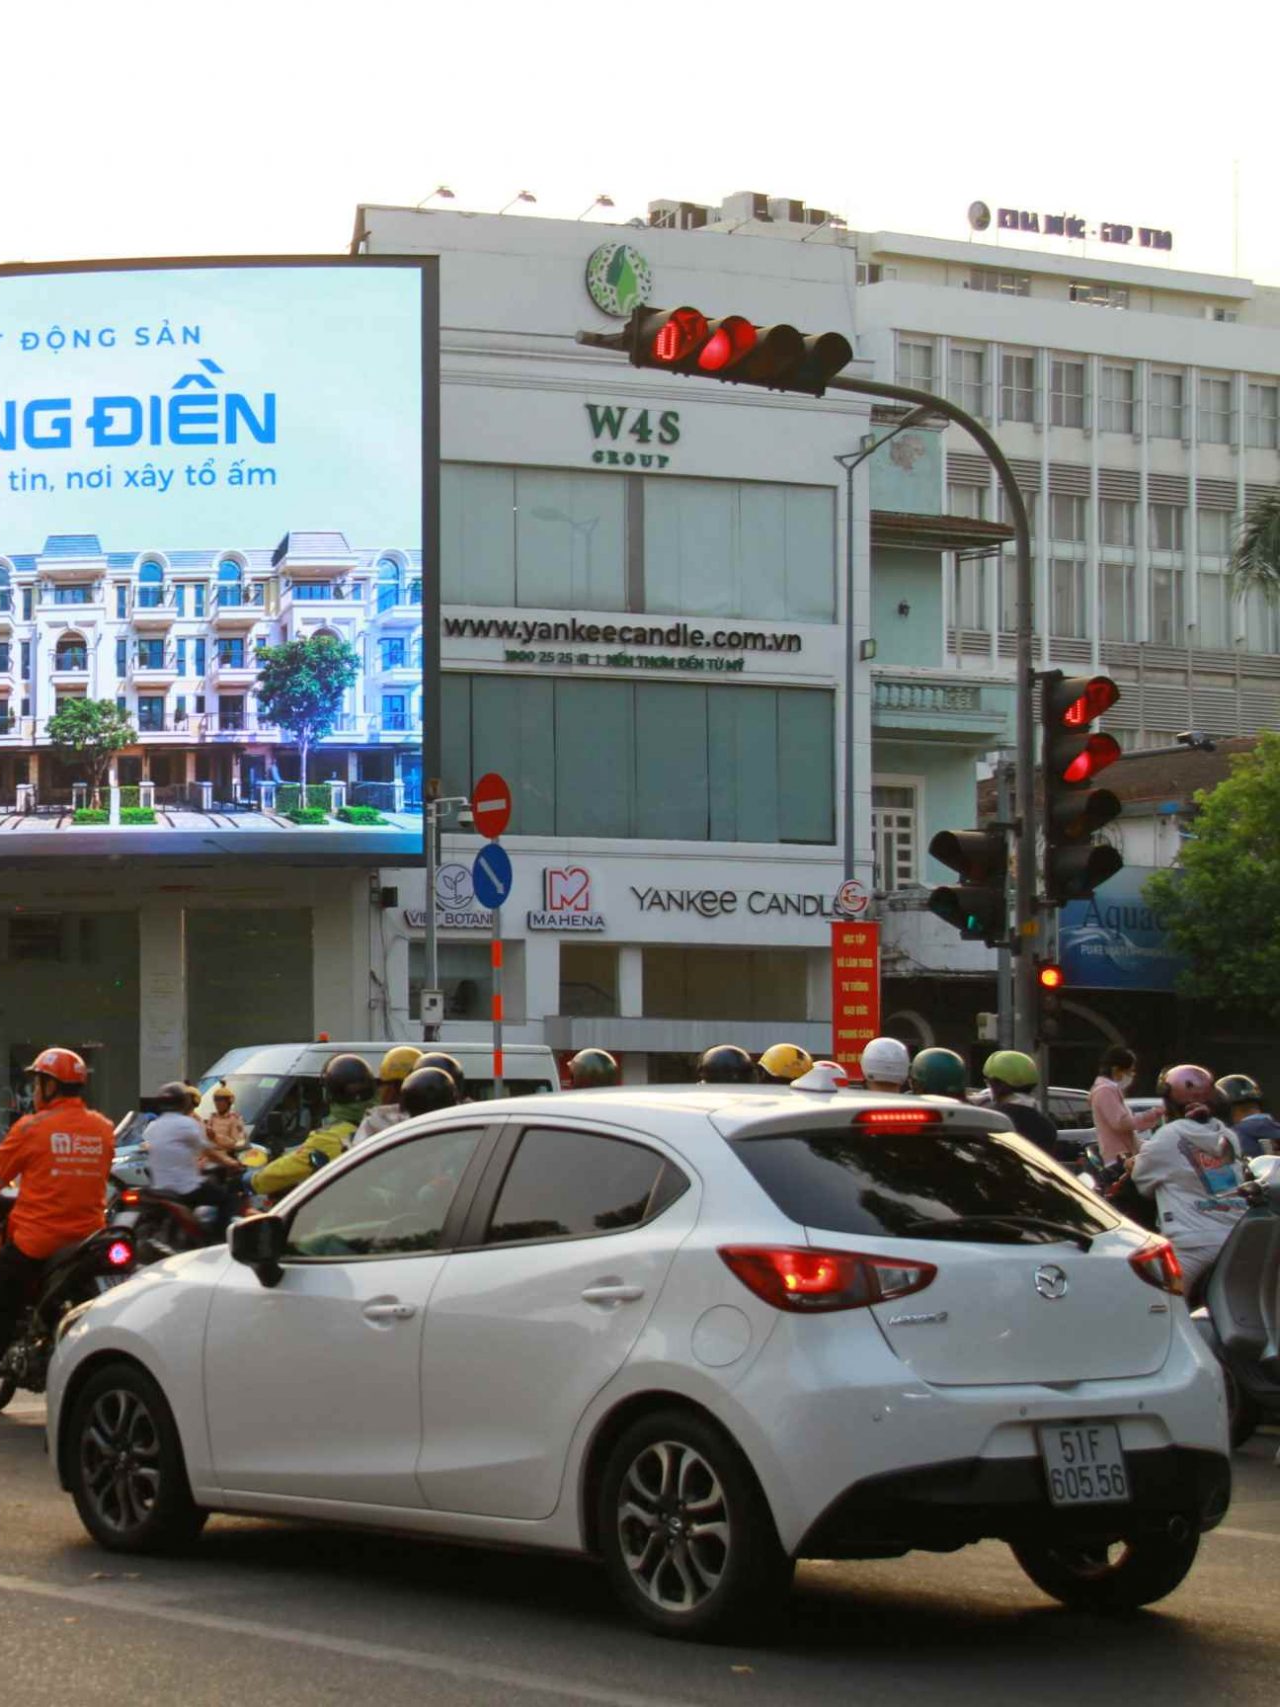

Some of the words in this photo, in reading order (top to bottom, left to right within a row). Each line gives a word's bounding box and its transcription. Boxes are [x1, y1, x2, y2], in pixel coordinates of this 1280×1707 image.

[20, 326, 115, 353] ĐỘNG
[136, 320, 200, 346] SẢN
[86, 359, 275, 447] ĐIỀN
[584, 403, 680, 444] W4S
[9, 468, 54, 491] tin,
[67, 465, 111, 489] nơi
[125, 463, 173, 492] xây
[186, 458, 216, 485] tổ
[228, 459, 275, 485] ấm
[592, 450, 669, 468] GROUP
[444, 617, 802, 652] www.yankeecandle.com.vn
[532, 913, 605, 927] MAHENA
[1059, 1428, 1098, 1464] 51F
[1050, 1463, 1125, 1500] 605.56
